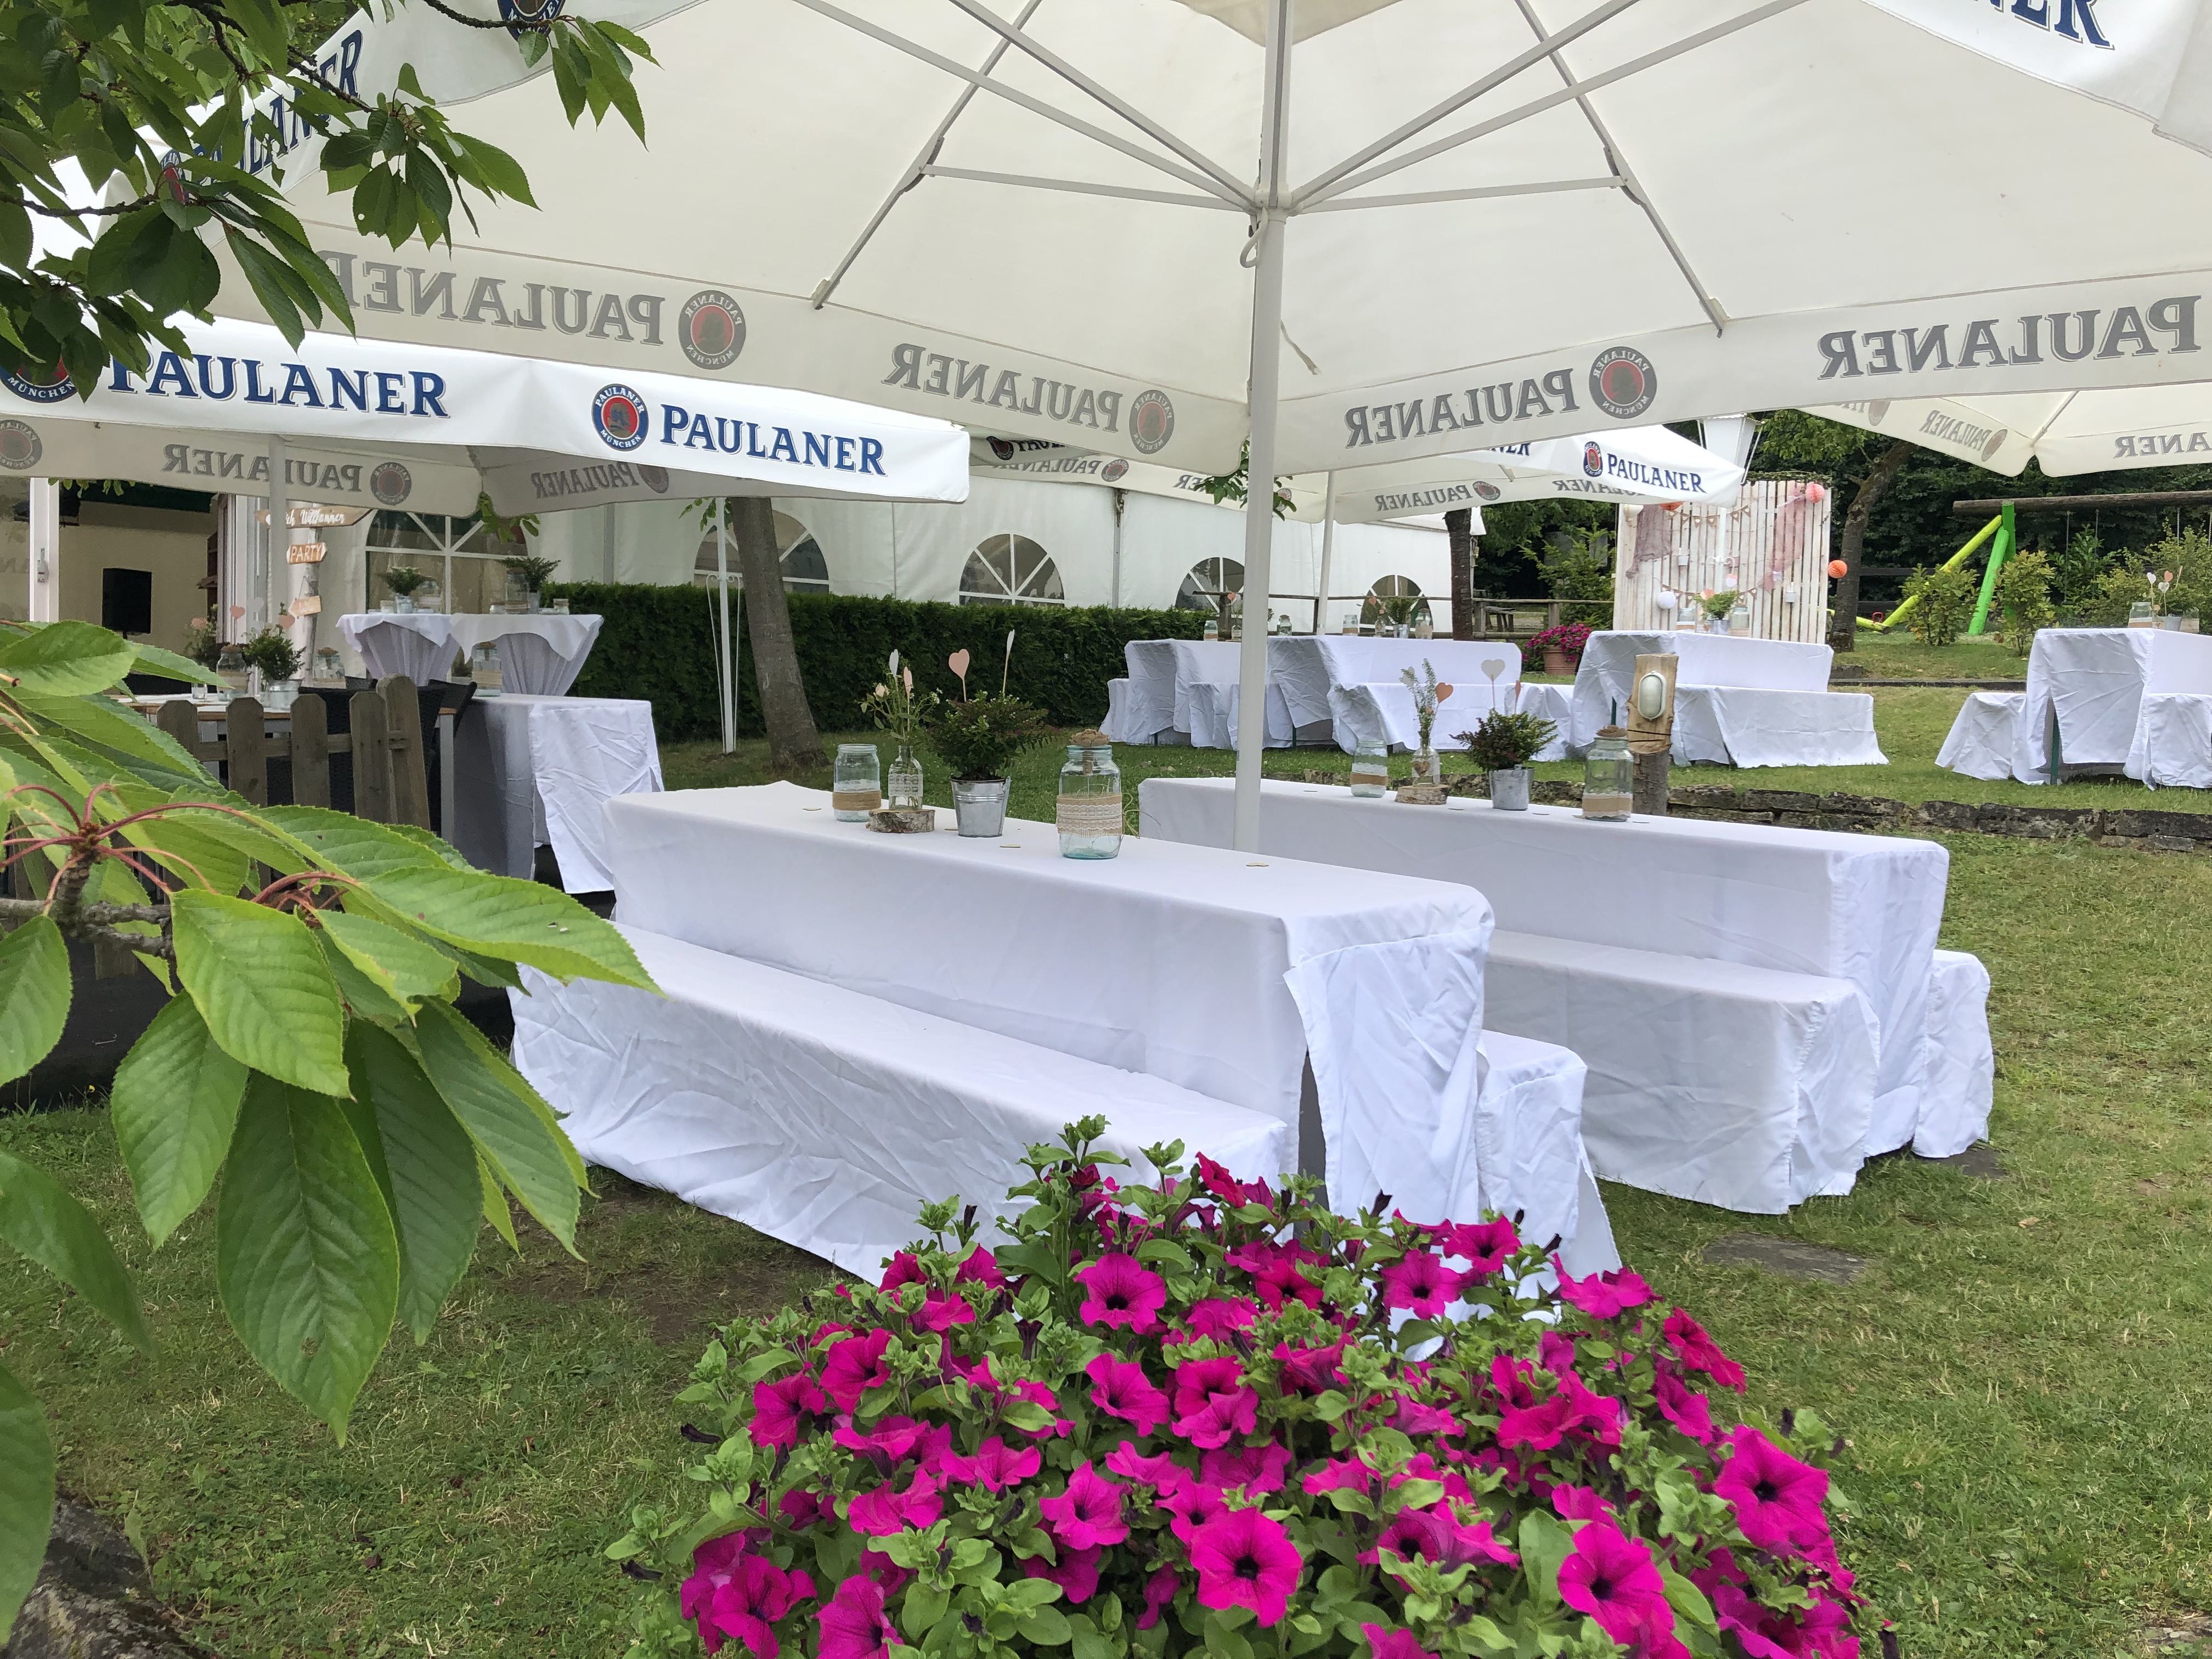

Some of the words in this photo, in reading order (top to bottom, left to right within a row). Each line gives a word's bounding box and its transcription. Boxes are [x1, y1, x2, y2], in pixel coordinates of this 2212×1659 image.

[595, 387, 645, 414] PAULANER
[600, 429, 641, 447] MÜNCHEN
[659, 404, 888, 477] PAULANER
[1607, 453, 1707, 494] PAULANER
[290, 544, 322, 562] PARTY
